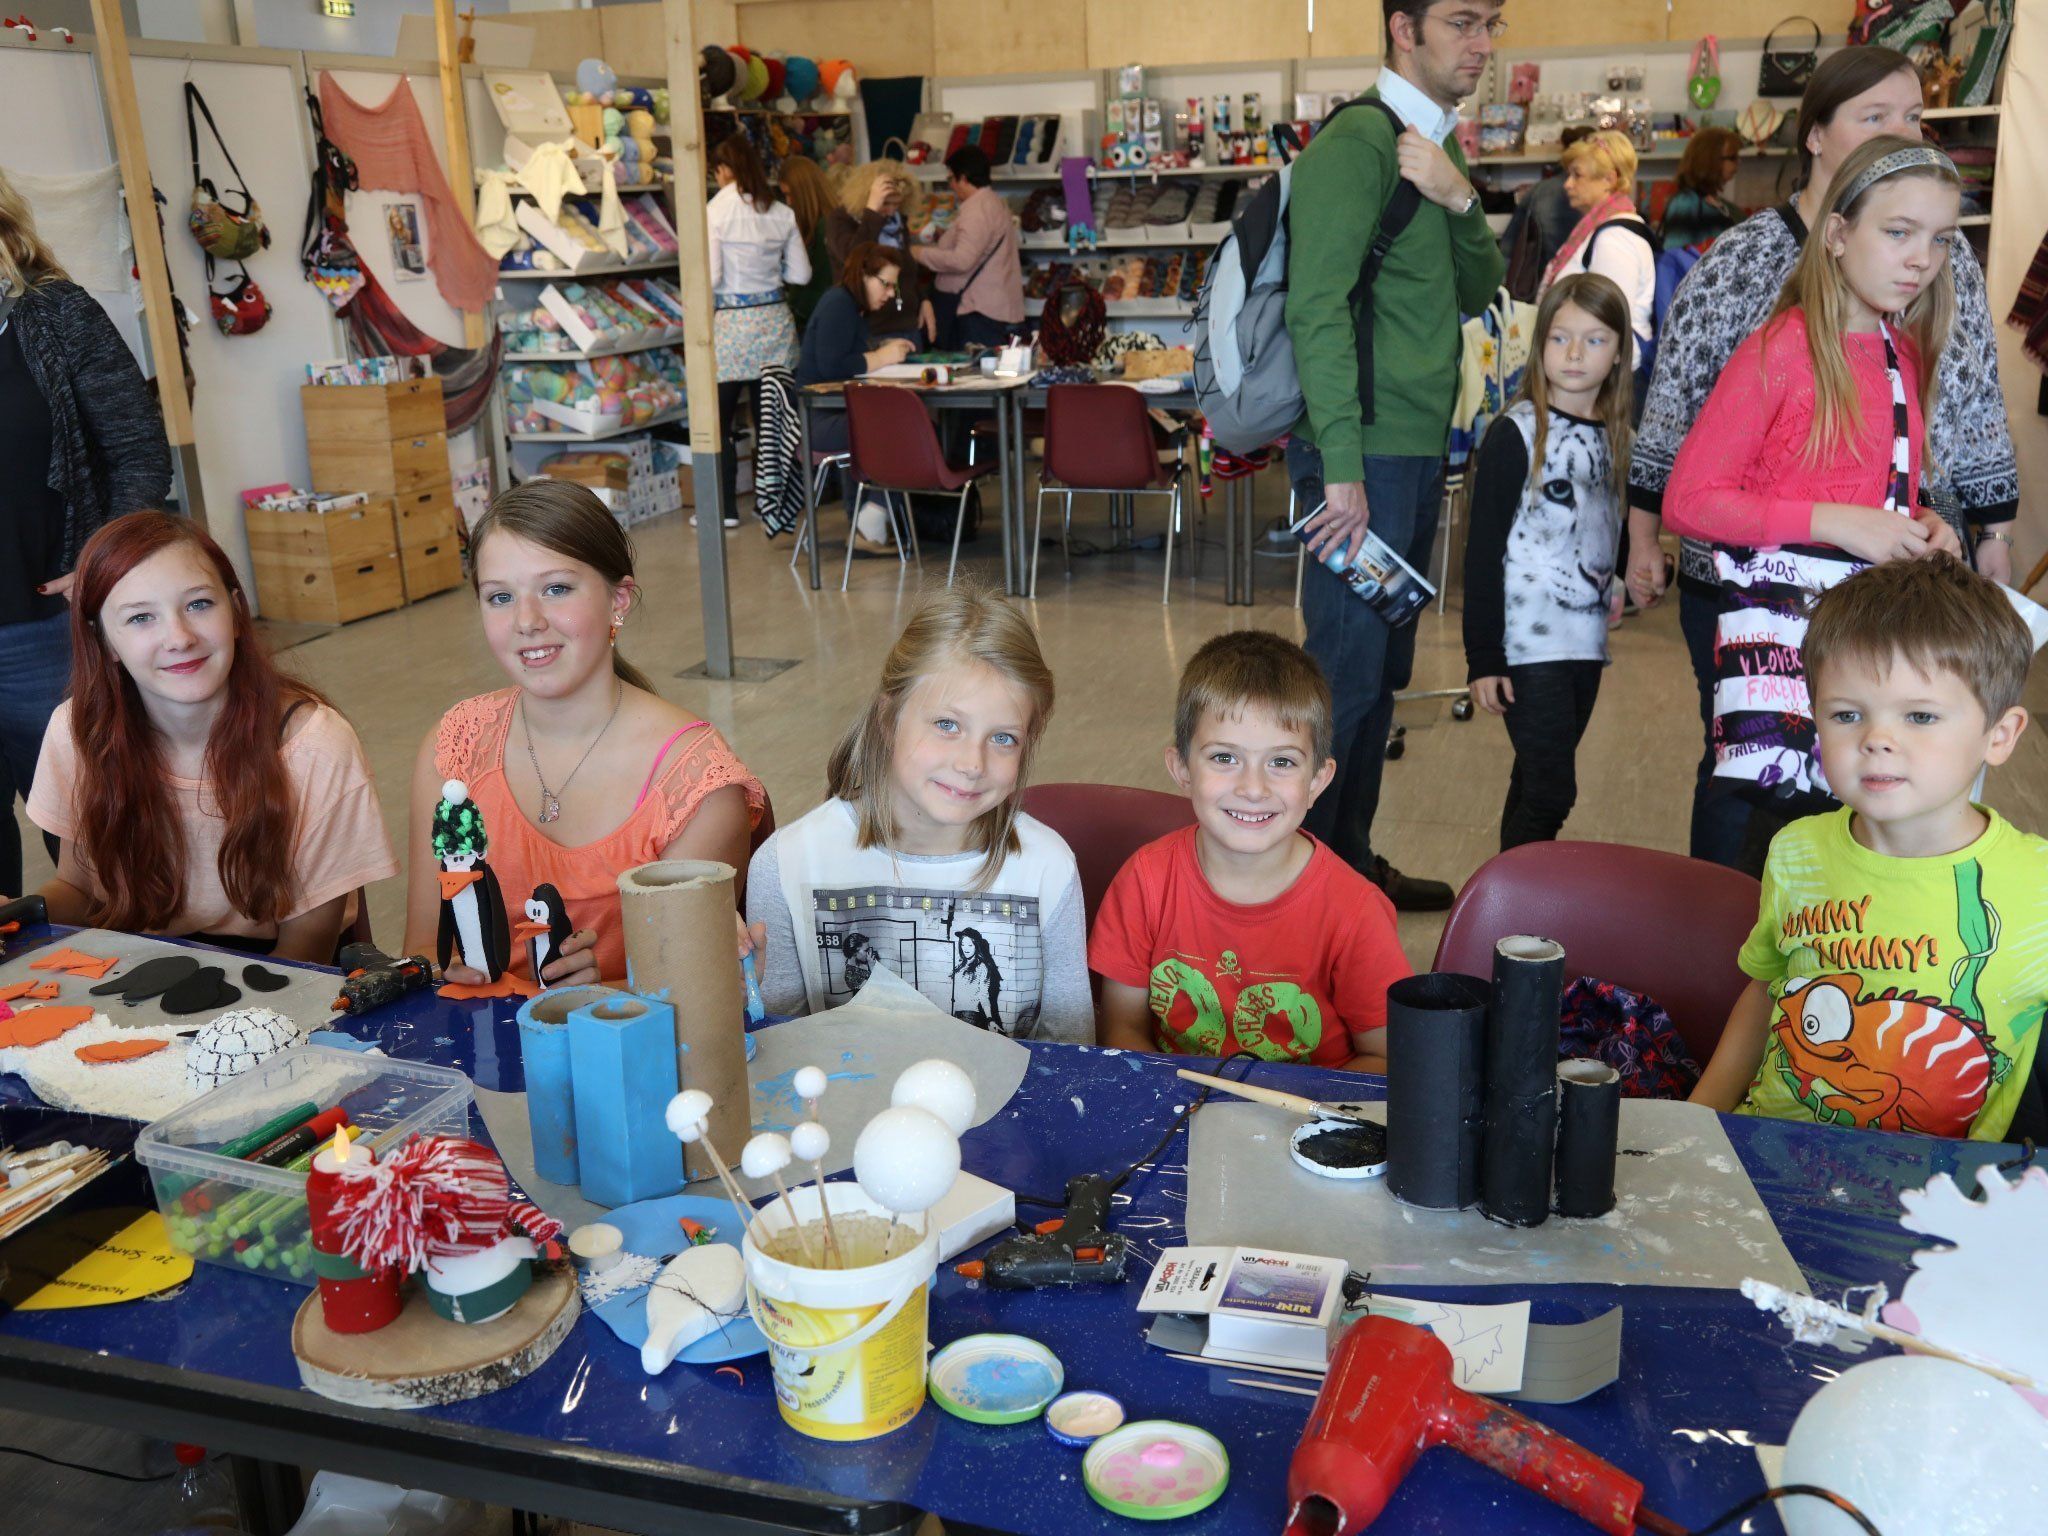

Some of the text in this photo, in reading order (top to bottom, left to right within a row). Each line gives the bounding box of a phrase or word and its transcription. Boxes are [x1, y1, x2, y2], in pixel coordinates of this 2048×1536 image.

[1727, 631, 1781, 651] MUSIC
[1746, 676, 1808, 706] FOREVE
[1728, 732, 1785, 760] FRIENDS
[1778, 894, 1872, 948] YUMMY
